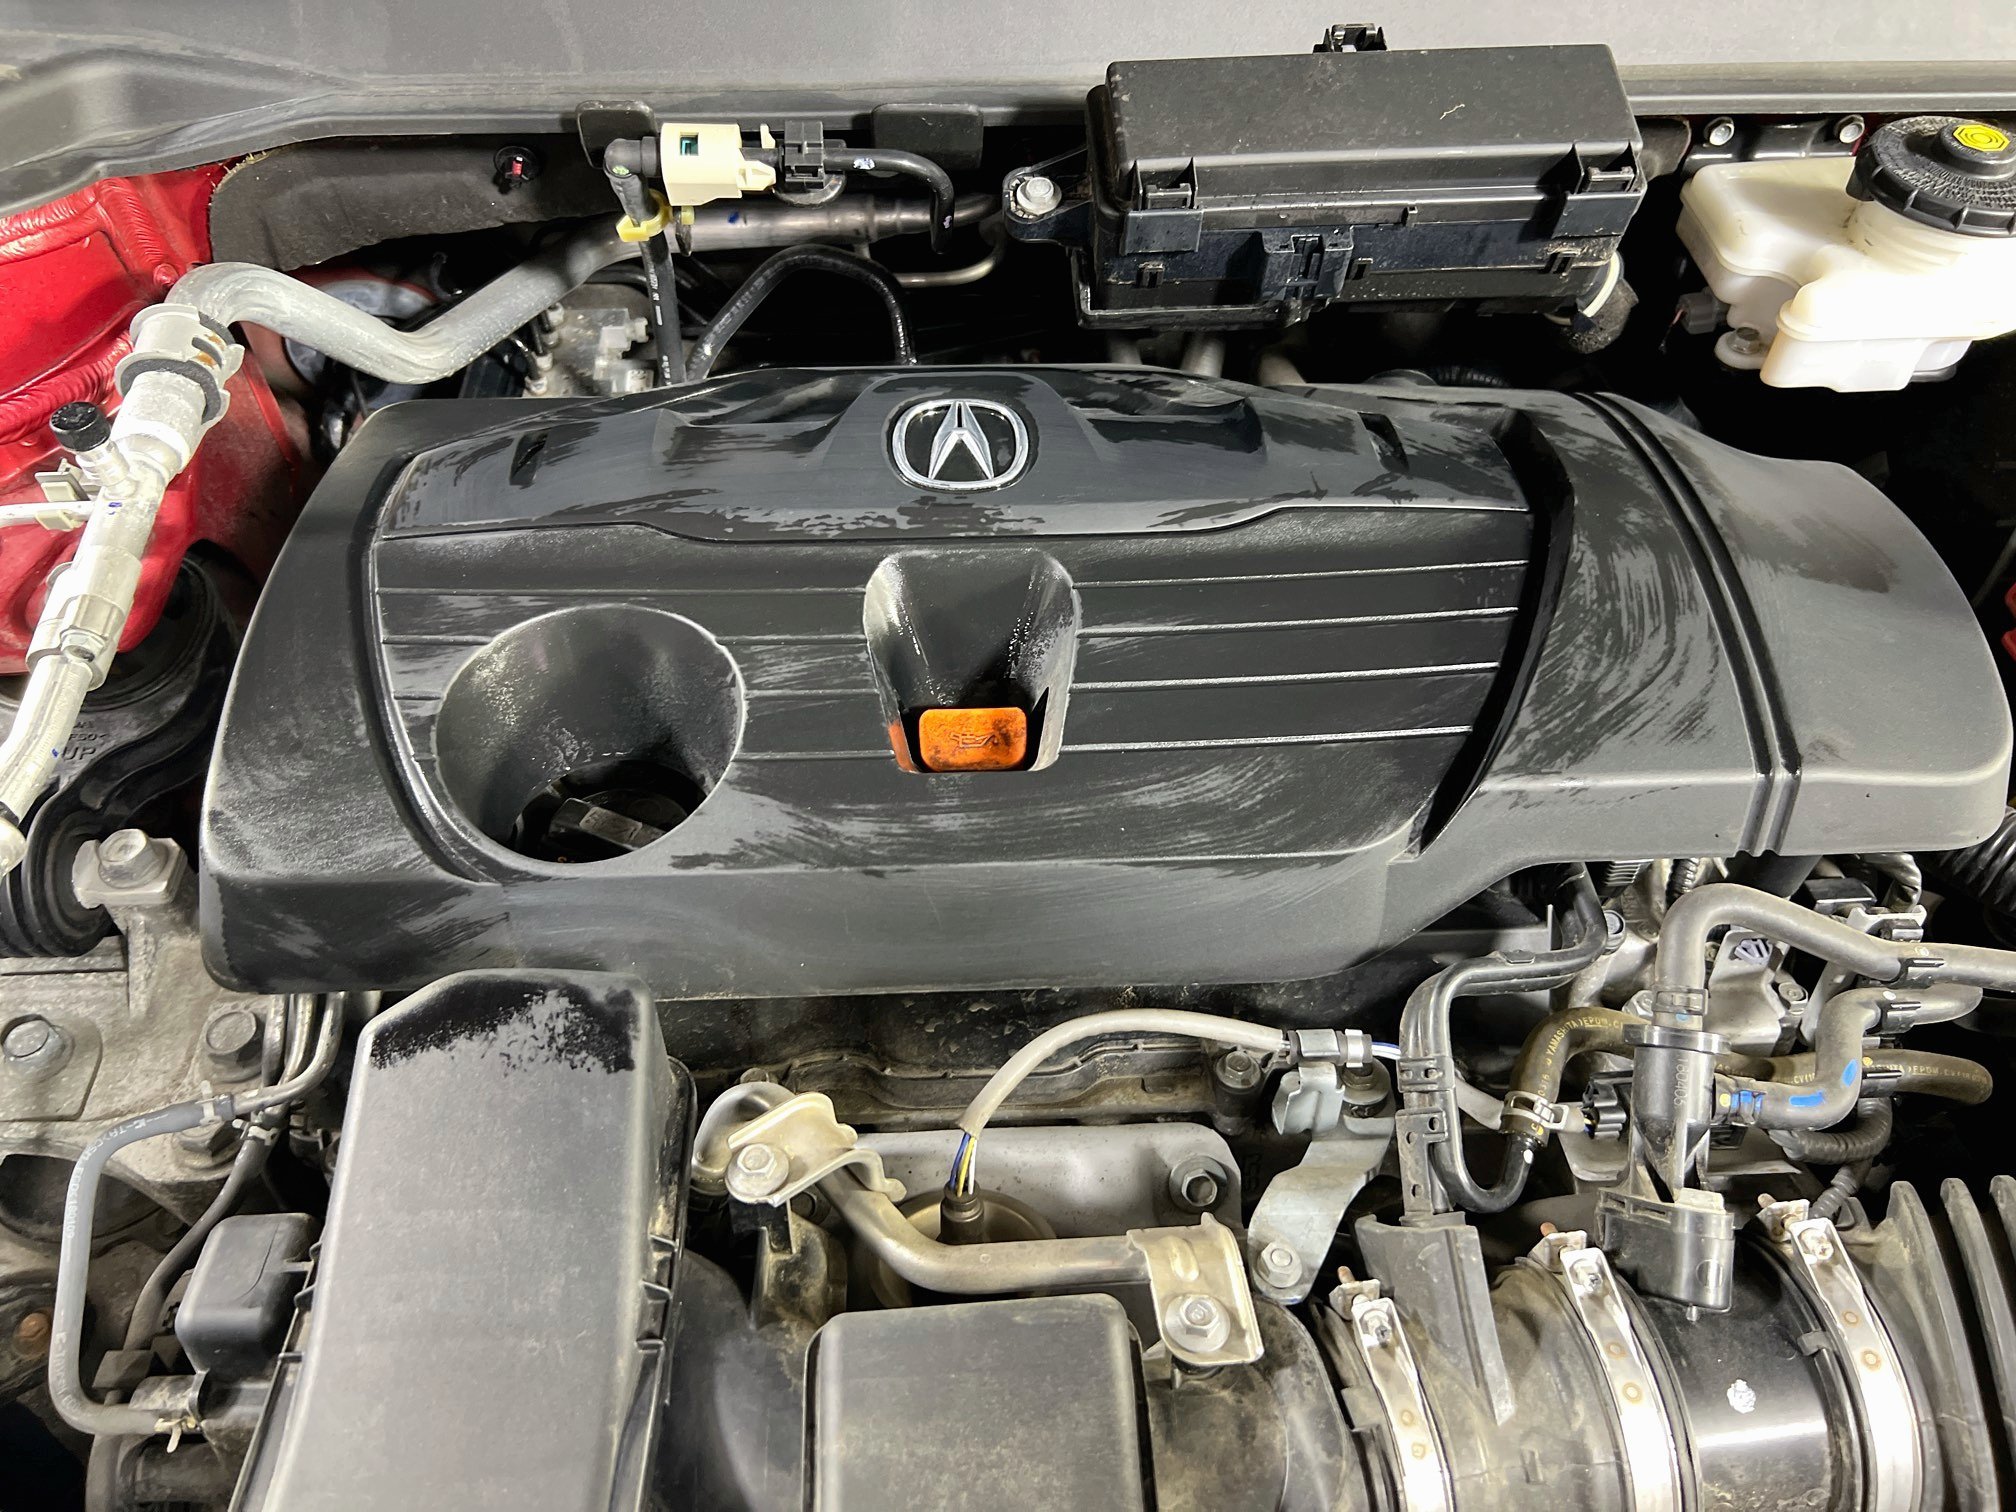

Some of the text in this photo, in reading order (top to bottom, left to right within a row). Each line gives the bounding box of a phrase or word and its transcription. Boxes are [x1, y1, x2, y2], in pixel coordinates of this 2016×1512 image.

[62, 746, 96, 760] UP
[1545, 1020, 1578, 1056] YAMASHITA
[1674, 1059, 1689, 1106] 160406
